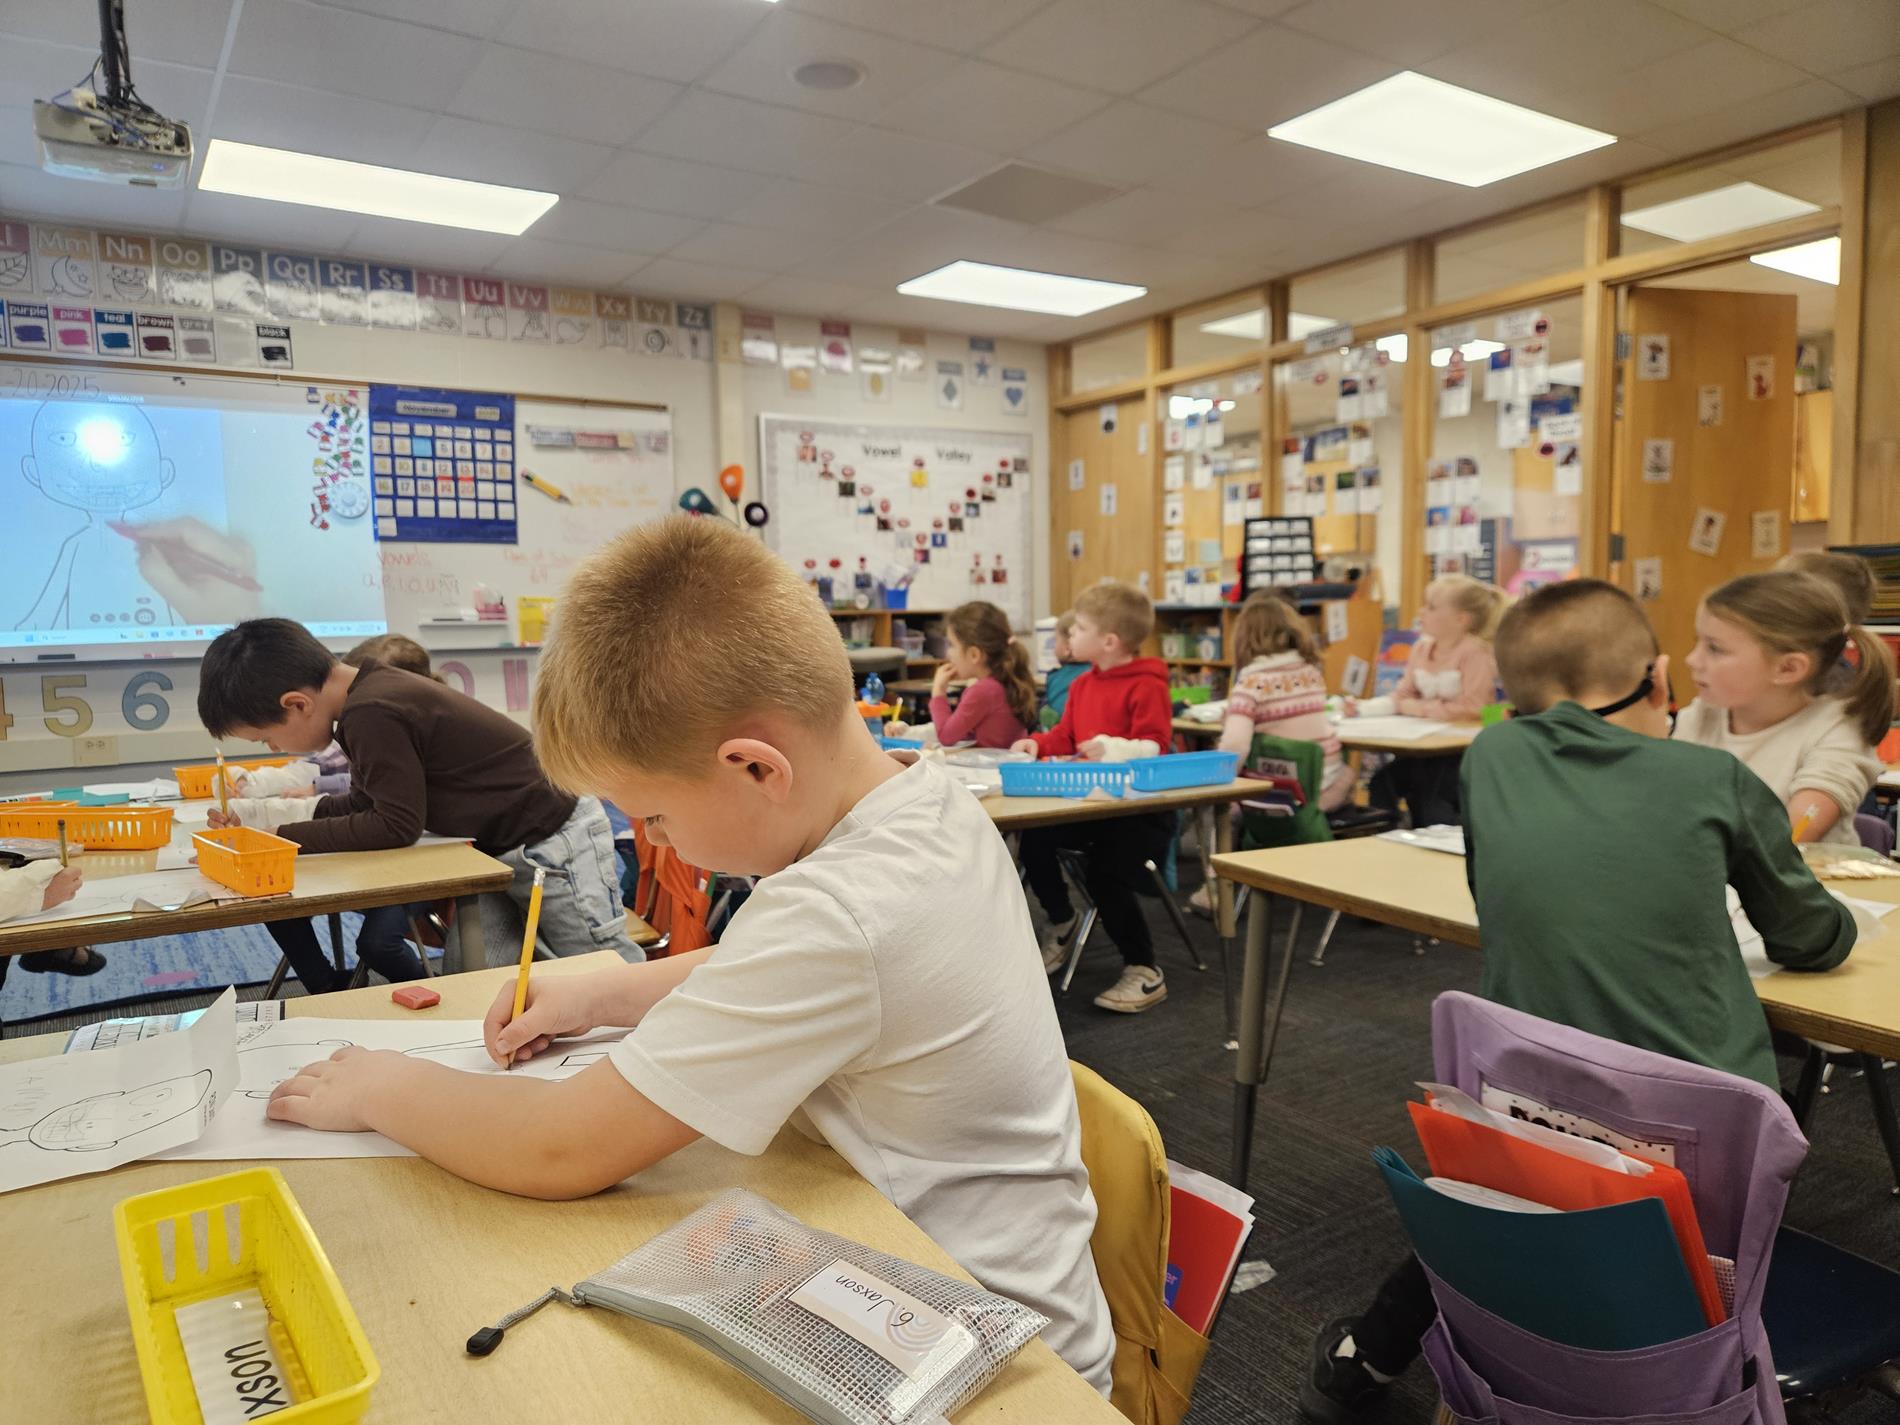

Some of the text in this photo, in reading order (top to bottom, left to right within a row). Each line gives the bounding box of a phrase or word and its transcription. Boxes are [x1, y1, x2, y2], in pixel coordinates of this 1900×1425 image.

[105, 236, 144, 259] Nn
[162, 242, 200, 266] Oo
[221, 248, 254, 275] Pp
[274, 256, 310, 285] Qq
[329, 263, 358, 285] Rr
[378, 268, 404, 290] Ss
[426, 275, 449, 296] Tt
[471, 280, 498, 302] Uu
[514, 285, 541, 307] Vv
[600, 298, 627, 316] Xx
[9, 304, 48, 318] purple
[60, 309, 84, 320] pink
[104, 312, 126, 323] teal
[138, 315, 174, 328] brown
[861, 443, 902, 457] Vowel
[41, 674, 93, 737] 5
[122, 671, 173, 731] 6
[836, 1275, 895, 1311] Jaxson
[224, 1340, 289, 1421] xson
